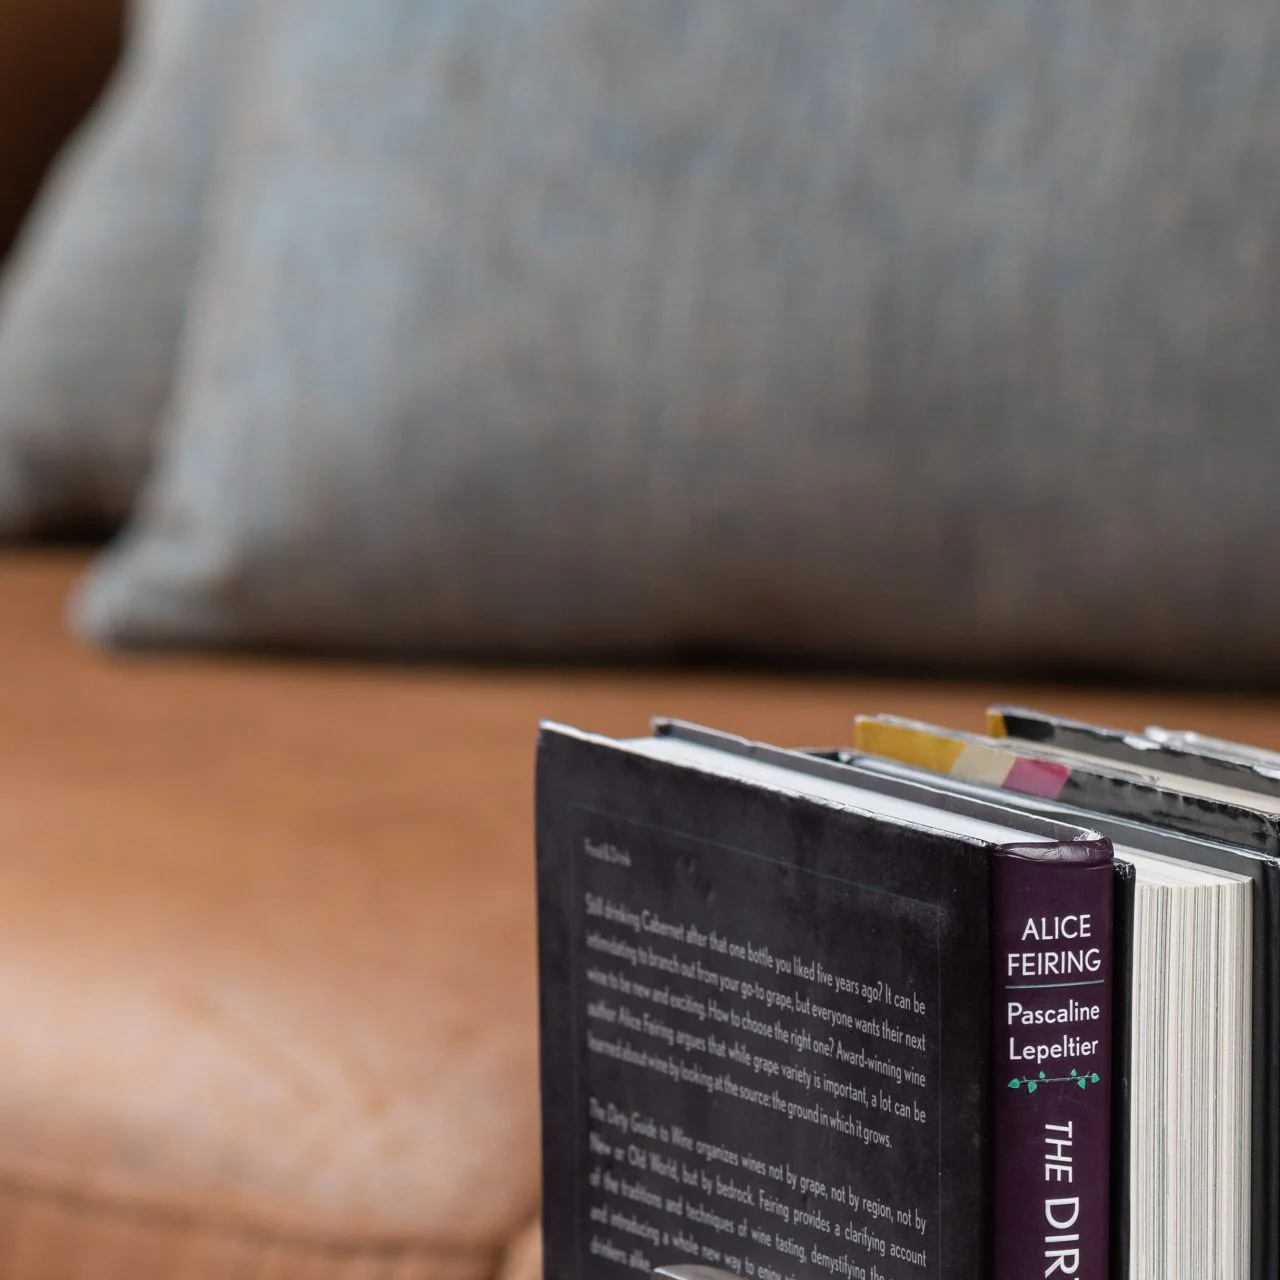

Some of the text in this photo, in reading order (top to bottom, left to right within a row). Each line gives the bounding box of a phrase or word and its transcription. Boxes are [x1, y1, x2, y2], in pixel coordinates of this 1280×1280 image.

[641, 909, 684, 941] Cabernet
[686, 924, 708, 947] after
[709, 930, 727, 954] that
[729, 943, 745, 959] one
[748, 941, 773, 968] bottle
[775, 957, 791, 974] you
[794, 955, 814, 981] liked
[817, 962, 832, 986] five
[835, 975, 859, 993] years
[862, 981, 882, 1003] ago?
[886, 983, 892, 1004] It
[894, 994, 911, 1011] can
[914, 992, 925, 1015] be
[1008, 949, 1100, 976] FEIRING
[1022, 914, 1090, 940] ALICE
[632, 982, 650, 998] new
[652, 985, 669, 1005] and
[708, 998, 729, 1022] How
[731, 1008, 740, 1027] to
[741, 1010, 773, 1038] choose
[775, 1021, 788, 1043] the
[791, 1028, 811, 1052] right
[813, 1037, 834, 1057] one?
[836, 1040, 902, 1084] Award-winning
[904, 1066, 926, 1087] wine
[648, 945, 678, 973] branch
[681, 961, 695, 979] out
[697, 961, 718, 986] from
[720, 975, 739, 991] your
[741, 982, 764, 1000] go-to
[766, 990, 794, 1012] grape,
[796, 992, 810, 1015] but
[812, 1004, 852, 1028] everyone
[855, 1017, 880, 1038] wants
[882, 1020, 902, 1043] their
[905, 1033, 925, 1051] next
[1008, 1000, 1099, 1025] Pascaline
[676, 1030, 705, 1051] argues
[708, 1034, 725, 1057] that
[728, 1041, 750, 1065] while
[753, 1055, 779, 1076] grape
[781, 1065, 811, 1089] variety
[814, 1071, 820, 1089] is
[823, 1074, 868, 1108] important,
[872, 1094, 876, 1107] a
[880, 1090, 891, 1112] lot
[895, 1104, 911, 1118] can
[914, 1101, 926, 1123] be
[1010, 1035, 1098, 1064] Lepeltier
[680, 1059, 713, 1092] looking
[724, 1074, 738, 1096] the
[739, 1085, 771, 1107] source:
[772, 1090, 786, 1112] the
[788, 1104, 818, 1123] ground
[820, 1108, 828, 1126] in
[830, 1110, 854, 1136] which
[856, 1120, 862, 1138] it
[864, 1128, 892, 1148] grows.
[671, 1125, 693, 1150] Wine
[696, 1141, 739, 1166] organizes
[741, 1153, 766, 1175] wines
[769, 1164, 783, 1181] not
[786, 1164, 797, 1190] by
[800, 1175, 827, 1199] grape,
[832, 1185, 845, 1203] not
[849, 1186, 859, 1211] by
[863, 1197, 893, 1222] region,
[897, 1207, 911, 1225] not
[915, 1209, 926, 1235] by
[1045, 1121, 1072, 1183] THE
[666, 1195, 682, 1216] and
[686, 1201, 734, 1233] techniques
[738, 1218, 747, 1238] of
[751, 1226, 771, 1247] wine
[776, 1234, 807, 1264] tasting,
[672, 1230, 698, 1255] whole
[702, 1246, 721, 1262] new
[723, 1253, 741, 1274] way
[745, 1257, 754, 1275] to
[682, 1163, 698, 1186] but
[702, 1170, 713, 1195] by
[759, 1189, 789, 1222] Feiring
[794, 1206, 830, 1233] provides
[834, 1223, 840, 1236] a
[845, 1221, 885, 1257] clarifying
[890, 1243, 926, 1268] account
